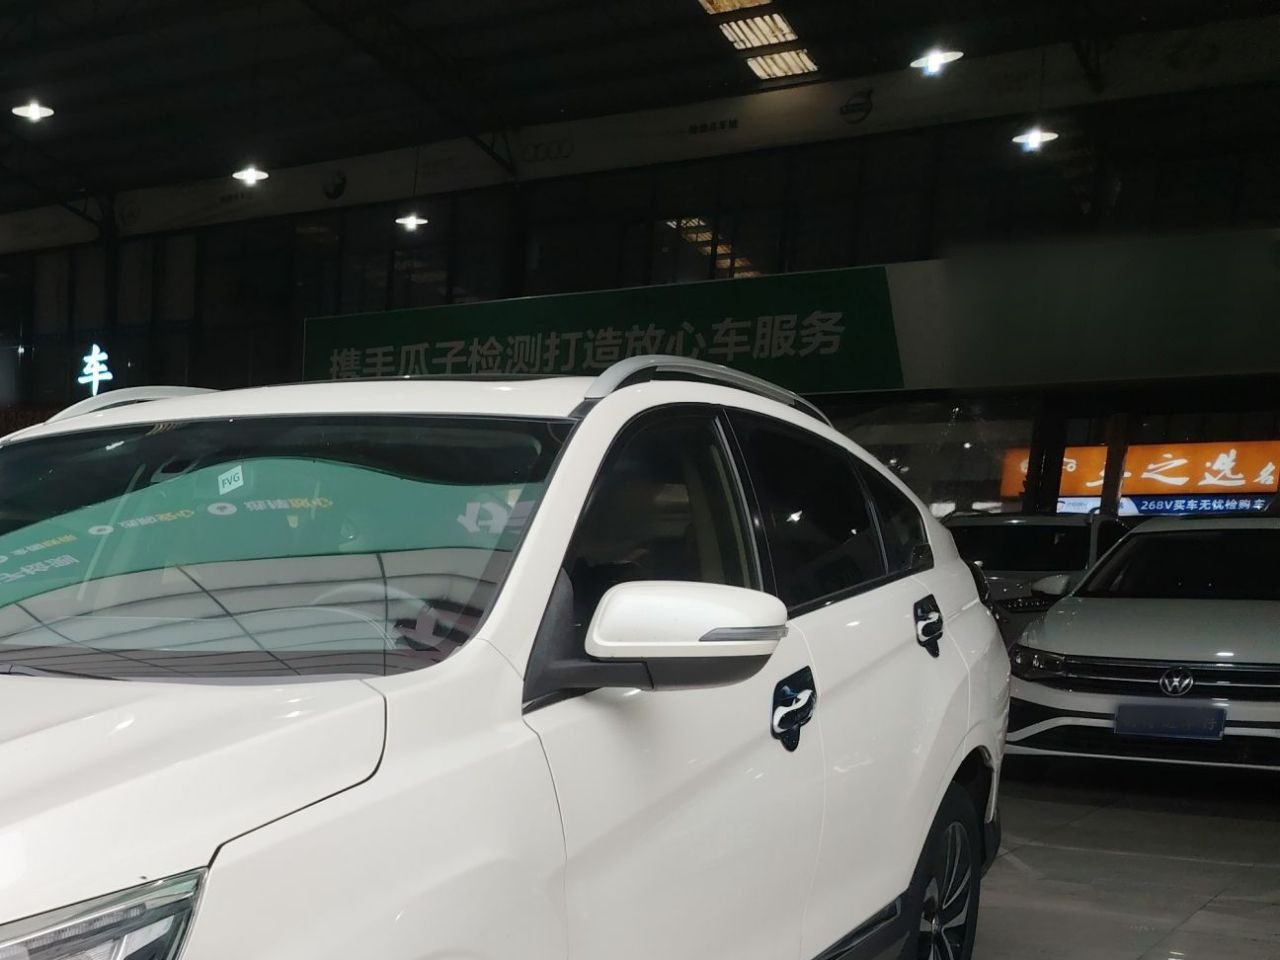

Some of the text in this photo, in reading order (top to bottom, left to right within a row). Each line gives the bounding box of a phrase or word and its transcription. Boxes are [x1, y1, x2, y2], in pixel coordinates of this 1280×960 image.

[77, 343, 114, 397] 车
[328, 309, 847, 379] 携手瓜子检测打造放心车服务
